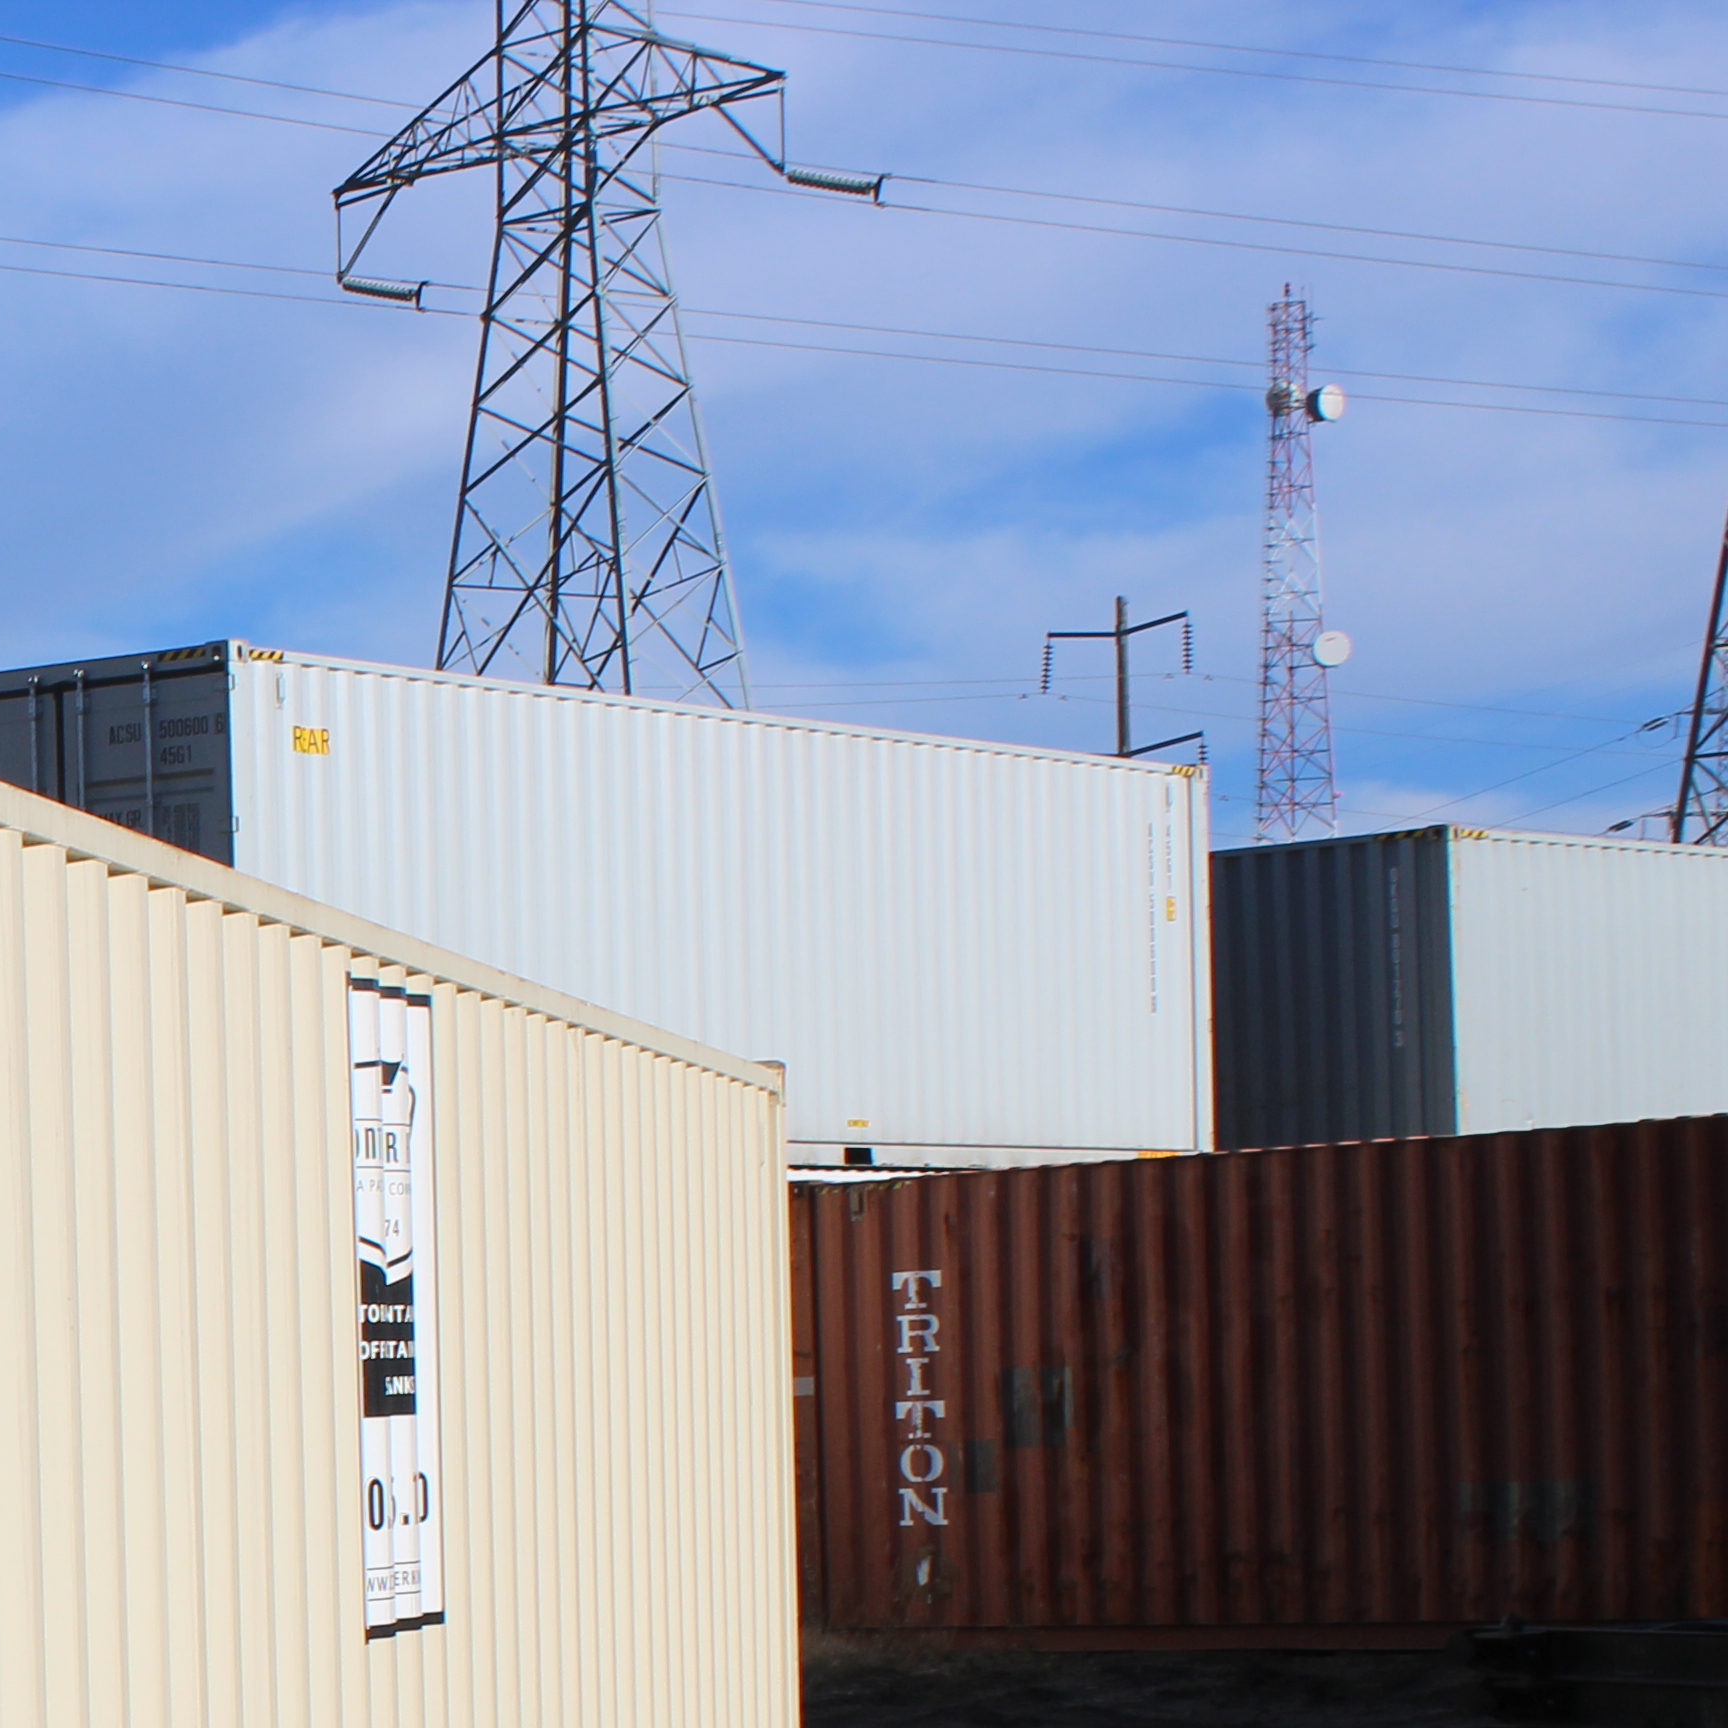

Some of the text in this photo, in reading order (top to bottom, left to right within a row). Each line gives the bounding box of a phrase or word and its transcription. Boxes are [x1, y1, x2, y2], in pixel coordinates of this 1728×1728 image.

[109, 722, 142, 745] ACSU
[159, 715, 209, 739] 500600
[293, 725, 330, 754] RAR
[160, 744, 192, 765] 45G1
[891, 1269, 949, 1527] TRITON
